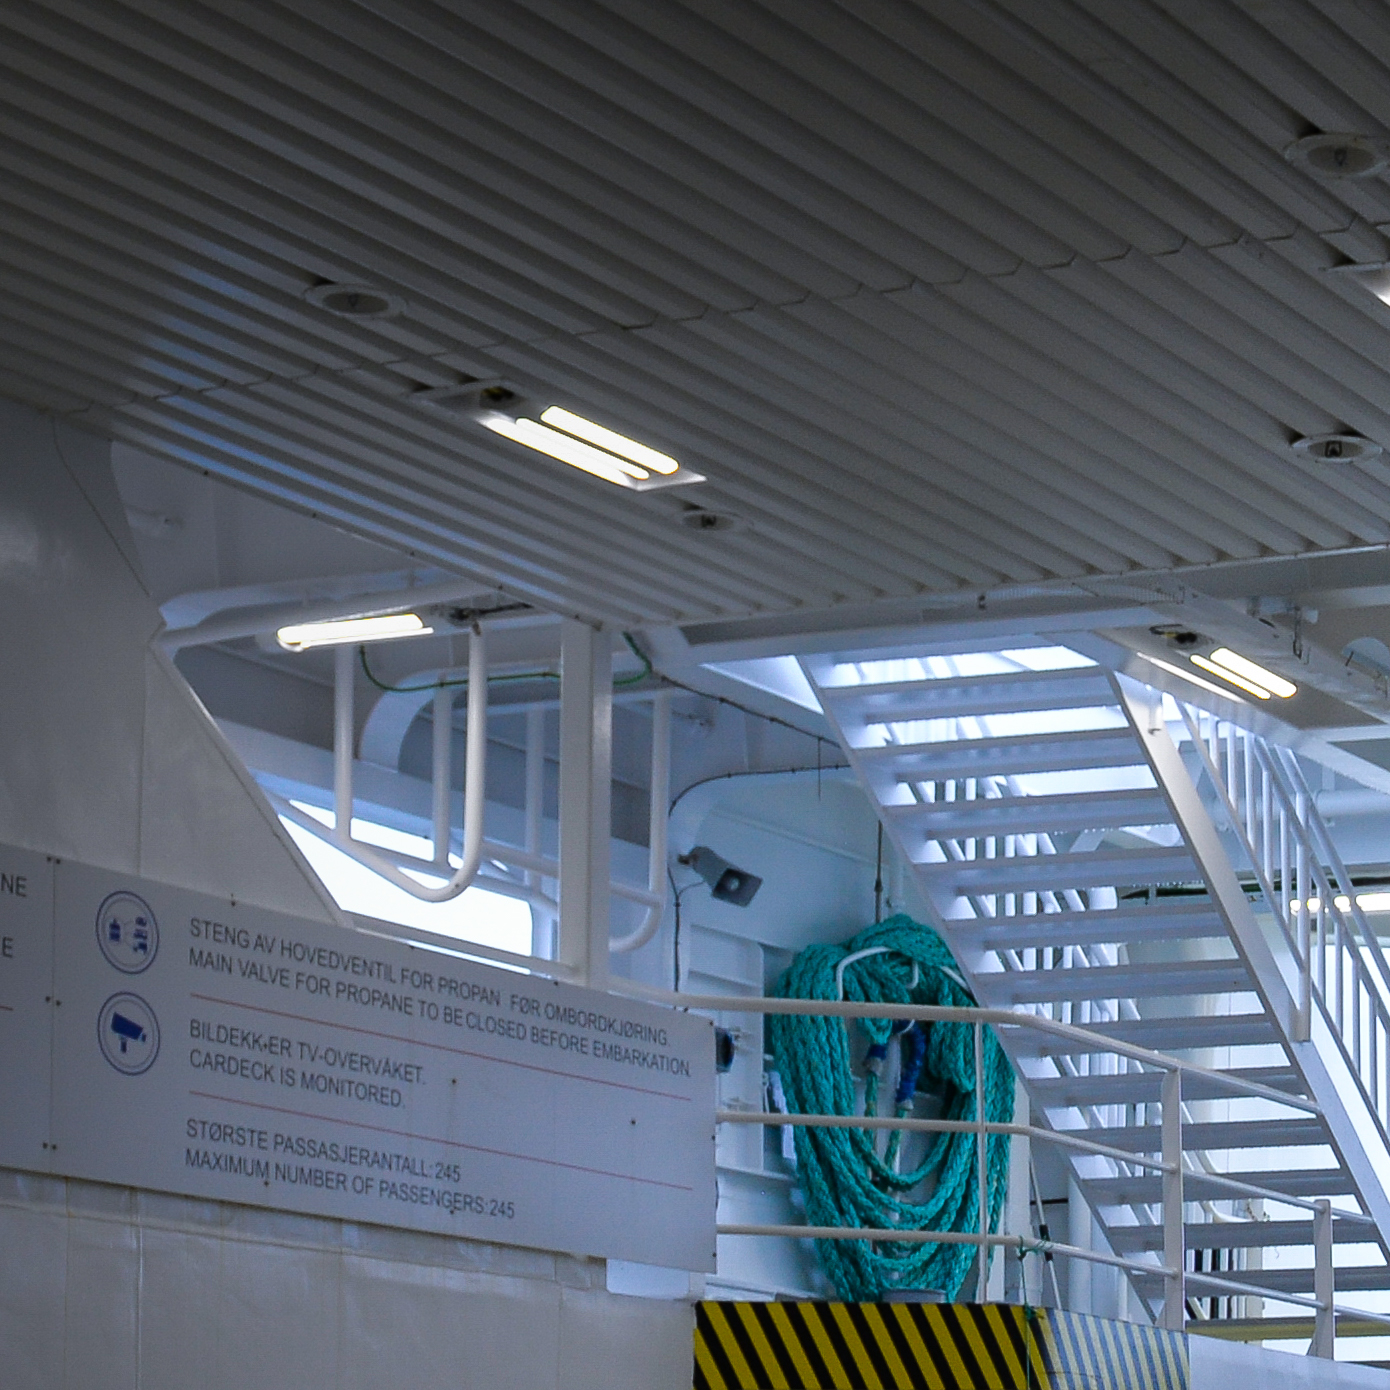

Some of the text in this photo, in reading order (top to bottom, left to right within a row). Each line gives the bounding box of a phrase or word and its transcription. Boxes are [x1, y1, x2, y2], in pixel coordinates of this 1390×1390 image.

[190, 917, 250, 949] STENG
[253, 934, 277, 953] AV
[280, 940, 396, 983] HOVEDVENTIL
[401, 968, 434, 992] FOR
[510, 994, 541, 1017] FØR
[189, 948, 233, 974] MAIN
[237, 960, 291, 988] VALVE
[295, 971, 331, 996] FOR
[335, 981, 414, 1016] PROPANE
[420, 999, 439, 1022] TO
[443, 1005, 464, 1027] BE
[465, 1011, 527, 1041] CLOSED
[531, 1025, 589, 1055] BEFORE
[189, 1048, 406, 1108] CARDECK IS MONITORED.
[186, 1118, 269, 1149] STØRSTE
[184, 1147, 270, 1179] MAXIMUM
[274, 1162, 348, 1192] NUMBER
[352, 1175, 374, 1195] OF
